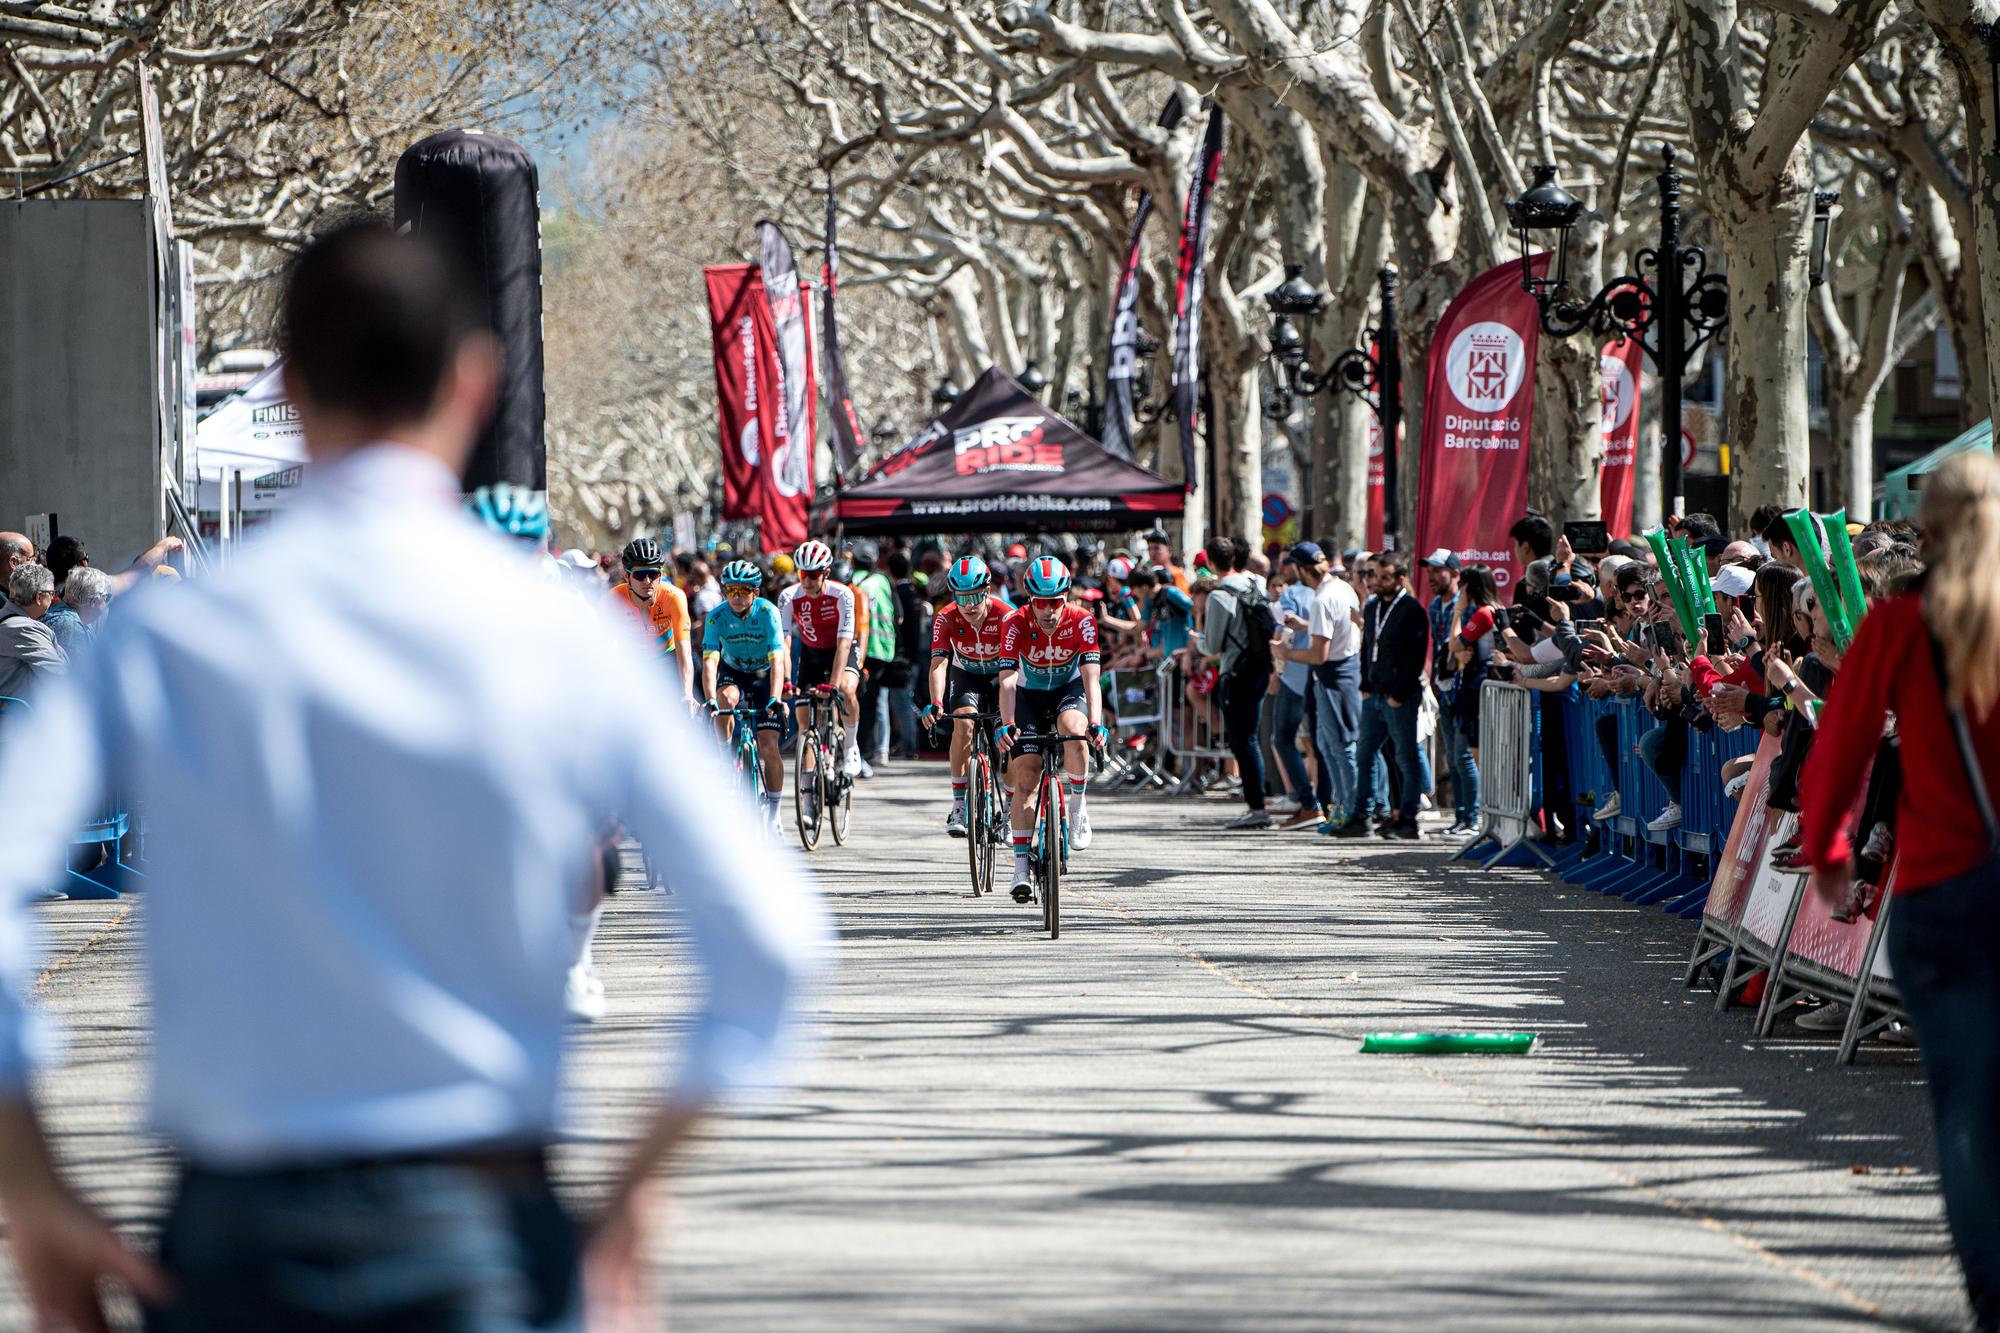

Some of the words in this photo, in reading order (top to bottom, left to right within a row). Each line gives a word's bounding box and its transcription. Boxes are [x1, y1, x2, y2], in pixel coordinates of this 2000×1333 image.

[255, 404, 300, 421] FINIS
[1445, 415, 1521, 433] Diputació
[954, 420, 1044, 456] PRO
[1445, 433, 1520, 450] Barcelona
[956, 444, 1065, 475] RIDE
[911, 495, 1111, 515] www.proridebike.com
